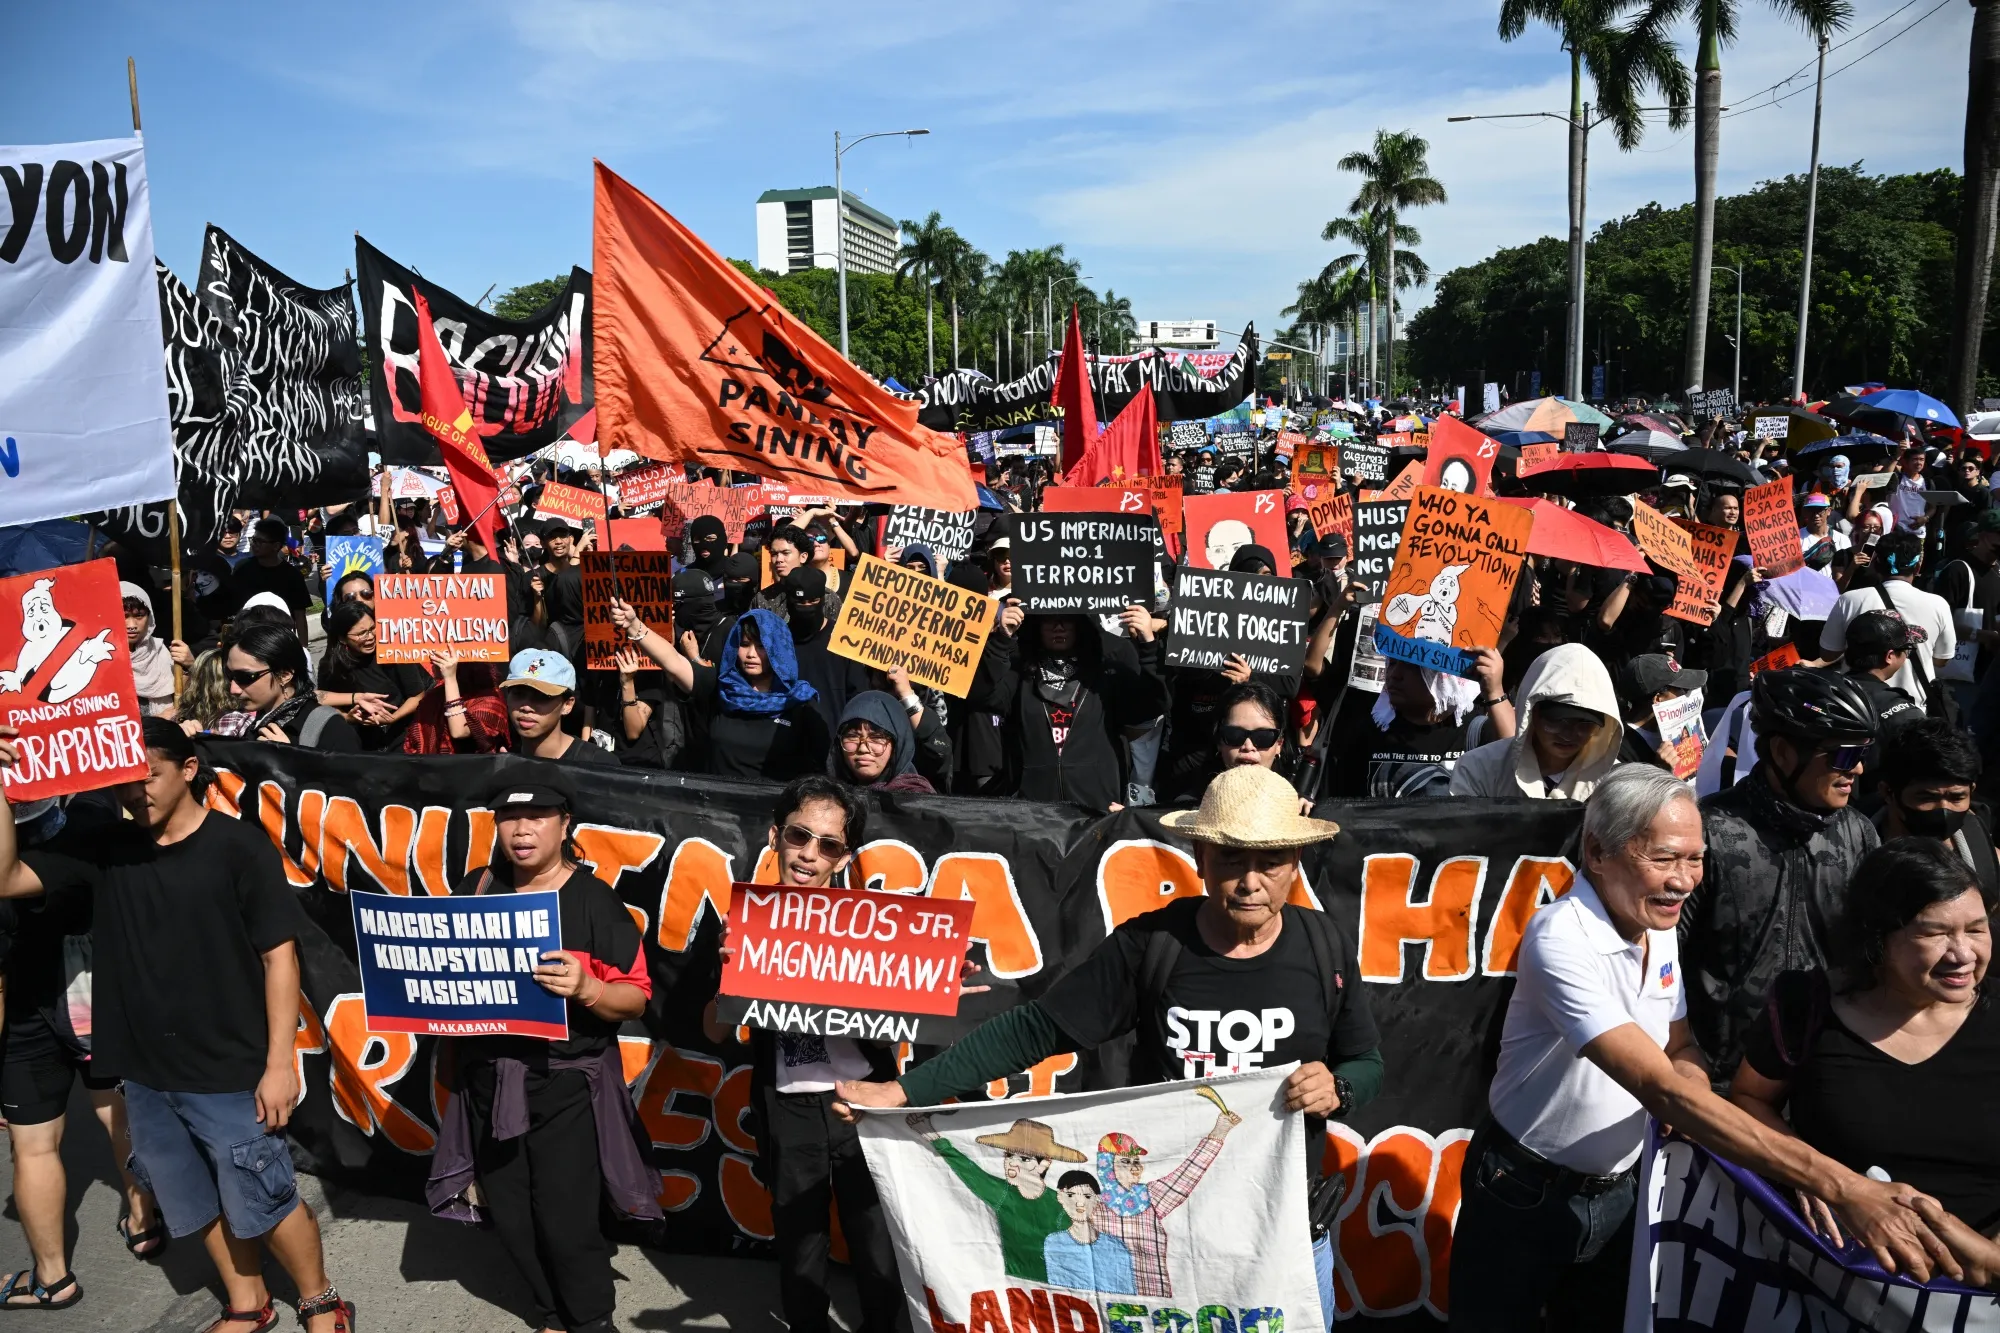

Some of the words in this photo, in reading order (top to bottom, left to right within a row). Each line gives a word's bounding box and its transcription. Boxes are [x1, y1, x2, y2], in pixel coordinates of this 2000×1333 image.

[978, 385, 994, 396] AT
[1692, 402, 1706, 410] AND
[1706, 394, 1734, 408] PROTECT
[1707, 388, 1731, 400] SERVE
[1706, 405, 1734, 419] PEOPLE
[421, 408, 450, 441] AGUE
[450, 429, 467, 452] OF
[726, 422, 867, 481] SINING
[1476, 438, 1498, 458] PS
[620, 486, 640, 499] LAKI
[643, 482, 652, 492] SA
[1120, 491, 1144, 512] PS
[1254, 493, 1276, 514] PS
[1746, 484, 1786, 506] BUWAYA
[1312, 495, 1351, 528] DPWH
[1418, 491, 1457, 516] WHO
[1465, 503, 1491, 526] YA
[1758, 500, 1772, 515] SA
[888, 514, 975, 549] MINDORO
[1020, 520, 1054, 542] US
[1060, 520, 1155, 542] IMPERIALIST
[1414, 514, 1482, 544] GONNA
[1486, 532, 1523, 557] CALL
[1634, 506, 1690, 552] HUSTISYA
[1746, 510, 1794, 536] KONGRESO
[1750, 530, 1788, 552] SIBAKIN
[1788, 528, 1800, 540] SA
[328, 541, 352, 570] NEVER
[356, 541, 384, 567] AGAIN
[1358, 558, 1384, 576] NG
[1408, 535, 1517, 591] REVOLUTION!
[1755, 542, 1801, 566] PWESTO!
[380, 576, 495, 600] KAMATAYAN
[1022, 564, 1136, 586] TERRORIST
[862, 562, 958, 613] NEPOTISMO
[961, 594, 987, 624] SA
[1030, 596, 1082, 610] PANDAY
[1087, 594, 1130, 610] SINING
[1179, 573, 1236, 600] NEVER
[1242, 581, 1298, 609] AGAIN!
[422, 600, 450, 616] SA
[377, 617, 509, 644] IMPERYALISMO
[846, 606, 908, 642] PAHIRAP
[911, 632, 927, 652] SA
[934, 640, 969, 668] MASA
[1174, 606, 1230, 640] NEVER
[1237, 612, 1306, 645] FORGET
[442, 648, 490, 661] SNING
[1376, 632, 1431, 664] PANDAY
[1430, 651, 1474, 674] SININ
[8, 702, 73, 728] PANDAY
[73, 692, 121, 716] SINING
[1880, 702, 1910, 719] ADIDAS
[1407, 754, 1428, 762] RIVER
[360, 908, 450, 939] MARCOS
[452, 912, 512, 940] HARI
[514, 909, 550, 938] NG
[742, 888, 902, 942] MARCOS
[908, 910, 960, 940] JR.
[374, 943, 511, 974] KORAPSYON
[514, 946, 540, 973] AT
[738, 934, 957, 994] MAGNANAKAW!
[404, 978, 519, 1006] PASISMO!
[428, 1022, 508, 1034] MAKABAYAN
[1166, 1006, 1296, 1054] STOP
[922, 1284, 1101, 1333] LAND
